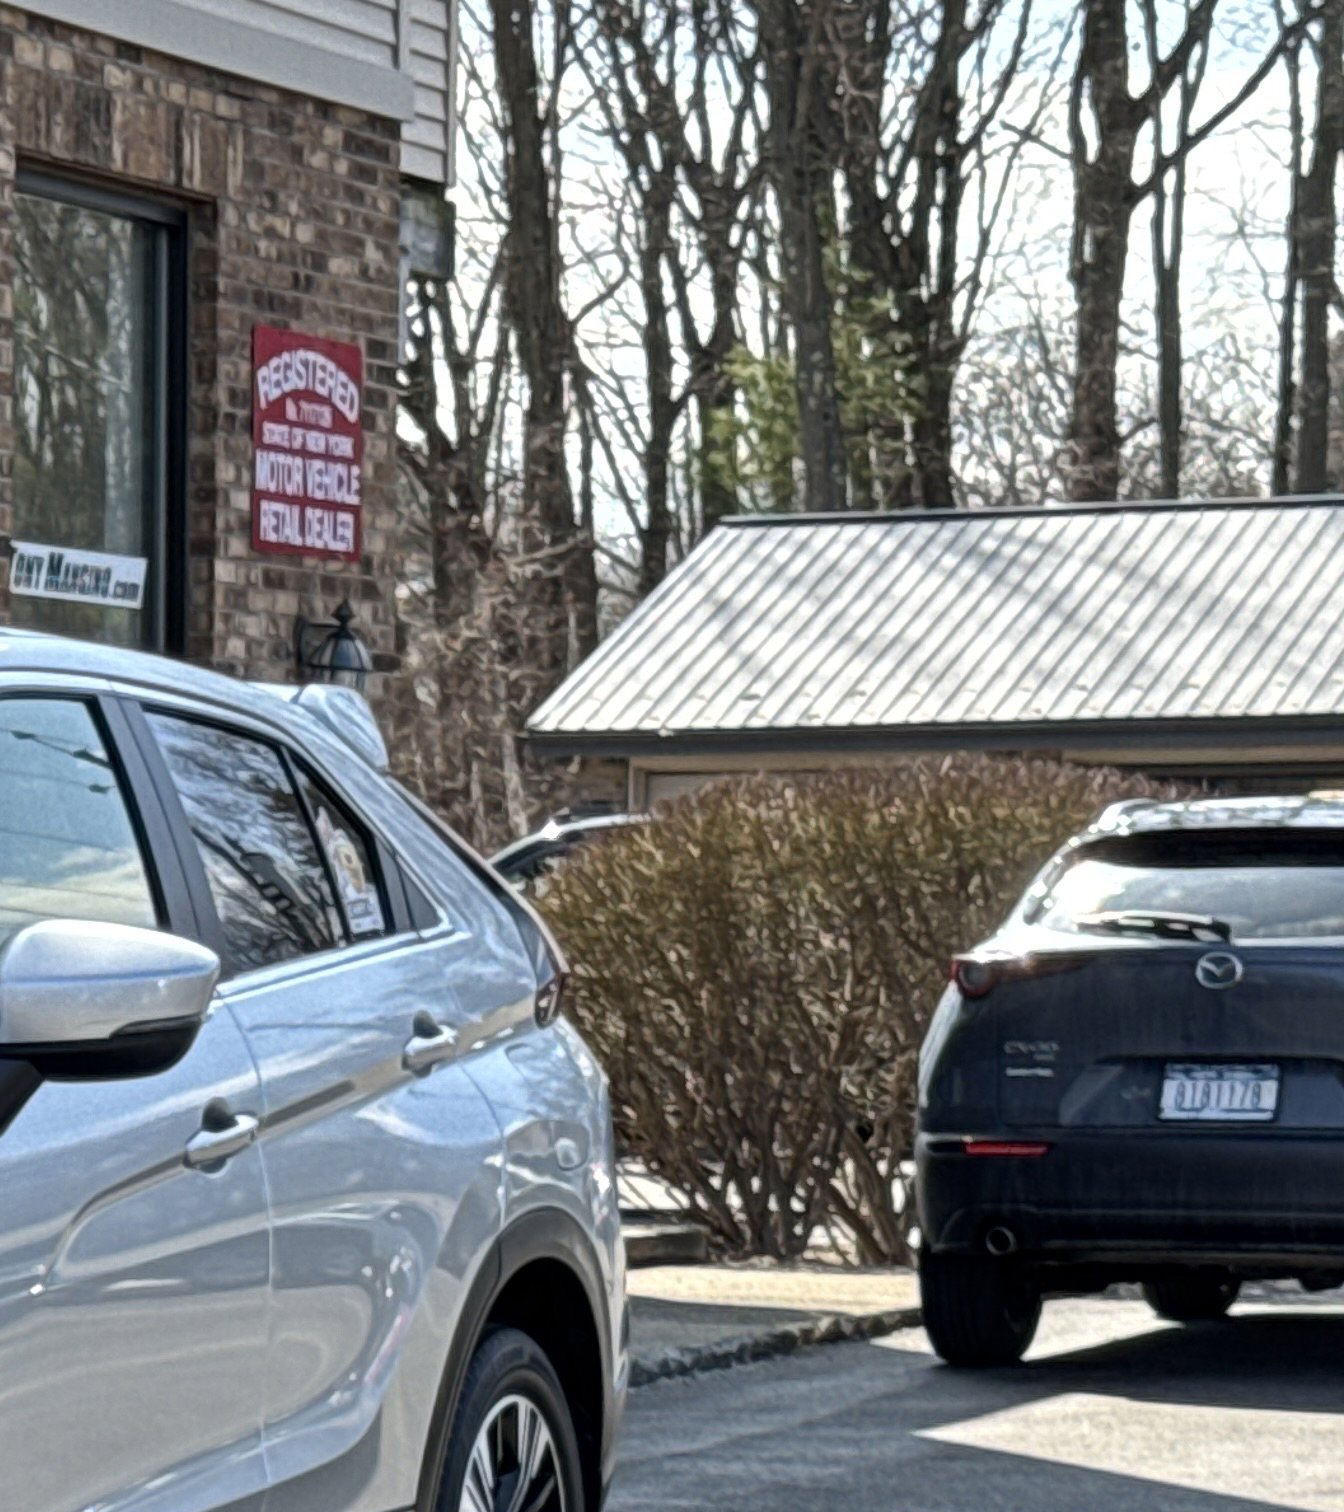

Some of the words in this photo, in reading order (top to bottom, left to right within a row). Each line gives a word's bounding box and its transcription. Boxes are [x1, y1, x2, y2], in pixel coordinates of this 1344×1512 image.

[257, 348, 359, 424] REGISTERED
[255, 448, 304, 497] MOTOR
[305, 458, 361, 506] VEHICLE
[260, 499, 303, 546] RETAIL
[305, 507, 354, 553] DEALER
